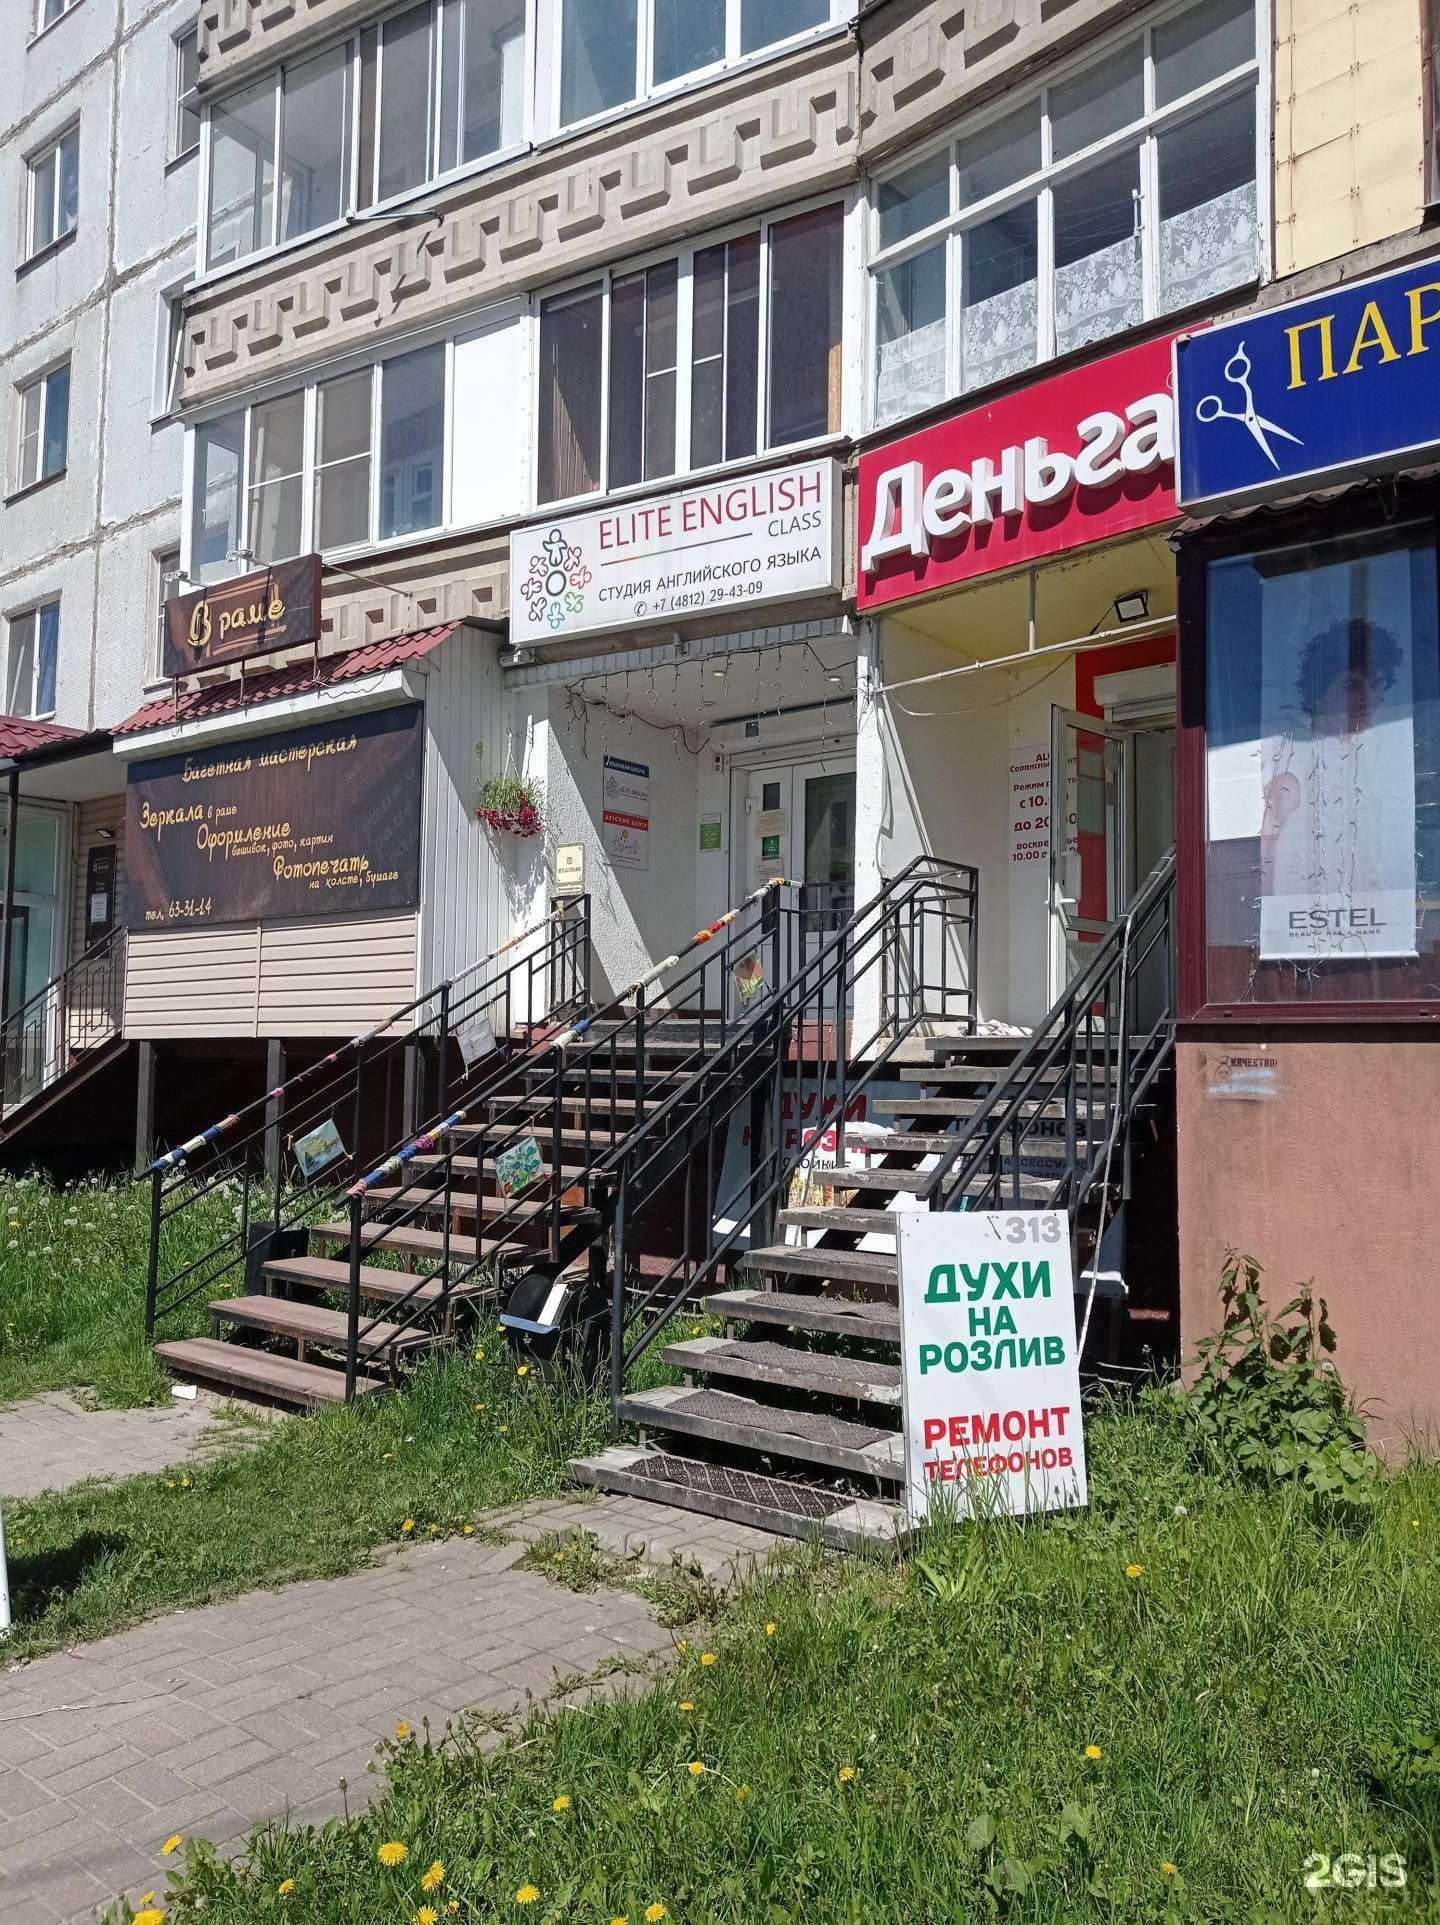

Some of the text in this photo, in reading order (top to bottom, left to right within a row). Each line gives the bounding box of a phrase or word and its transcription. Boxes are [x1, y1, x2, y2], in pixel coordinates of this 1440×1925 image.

[861, 392, 1176, 574] Деньга
[599, 471, 821, 550] ELITE ENGLISH
[768, 510, 822, 537] CLASS
[598, 546, 821, 601] СТУДИЯ АНГЛИЙСКОГО ЯЗЫКА
[652, 580, 763, 611] +7 (4812) 29-43-09
[188, 599, 285, 646] В раме
[181, 734, 359, 783] Багетная мастерская
[139, 801, 204, 842] Зеркала
[215, 804, 237, 825] раме
[196, 821, 292, 862] Оформление
[272, 853, 369, 882] Фотопечать
[308, 879, 320, 890] на
[365, 870, 399, 888] бумаге
[1289, 908, 1387, 929] ESTEL
[1006, 1215, 1061, 1244] 313
[924, 1260, 1051, 1304] ДУХИ
[968, 1305, 1018, 1337] НА
[919, 1336, 1066, 1375] РОЗЛИВ
[924, 1406, 1070, 1450] РЕМОНТ
[924, 1447, 1073, 1482] ТЕЛЕФОНОВ
